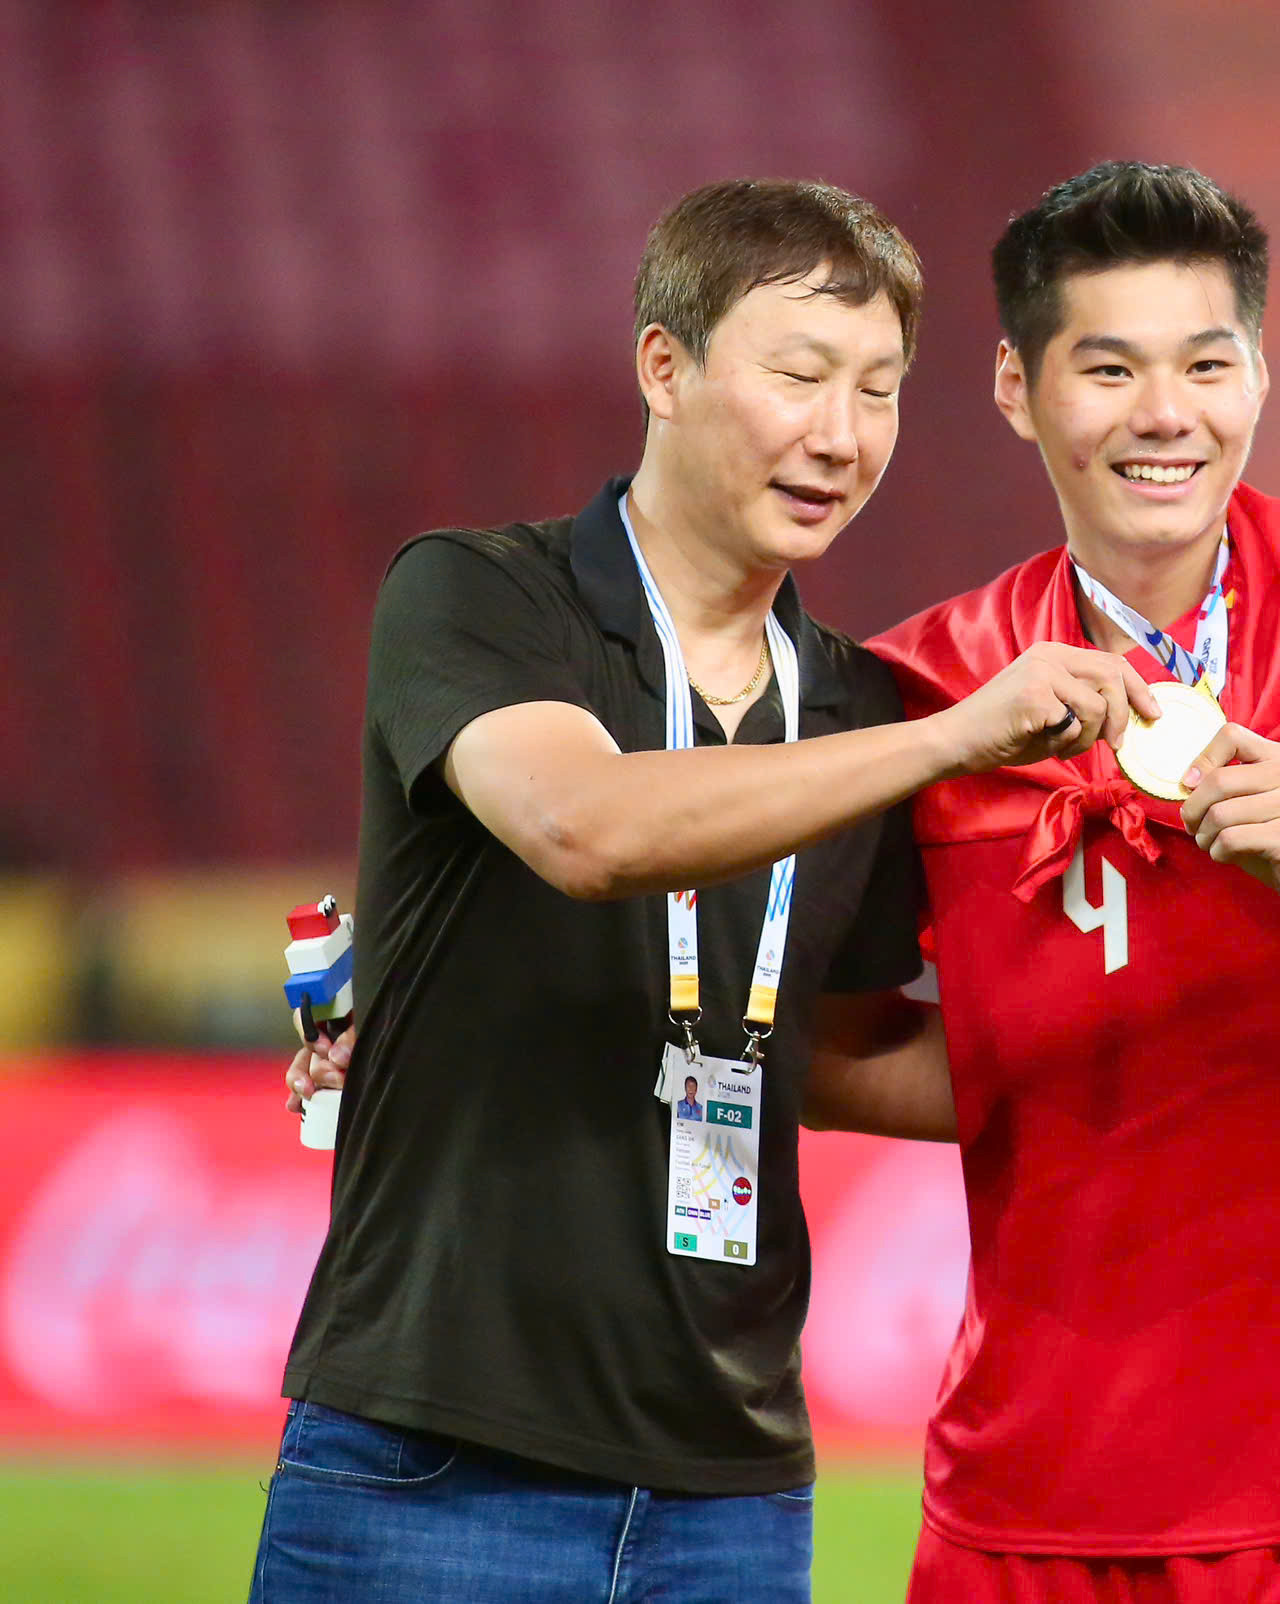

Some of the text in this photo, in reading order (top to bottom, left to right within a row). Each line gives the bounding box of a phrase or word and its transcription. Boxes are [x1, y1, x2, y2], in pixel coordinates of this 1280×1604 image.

[1063, 835, 1129, 976] 4
[718, 1081, 752, 1095] THAILAND
[717, 1107, 742, 1123] F-02
[682, 1236, 689, 1248] S
